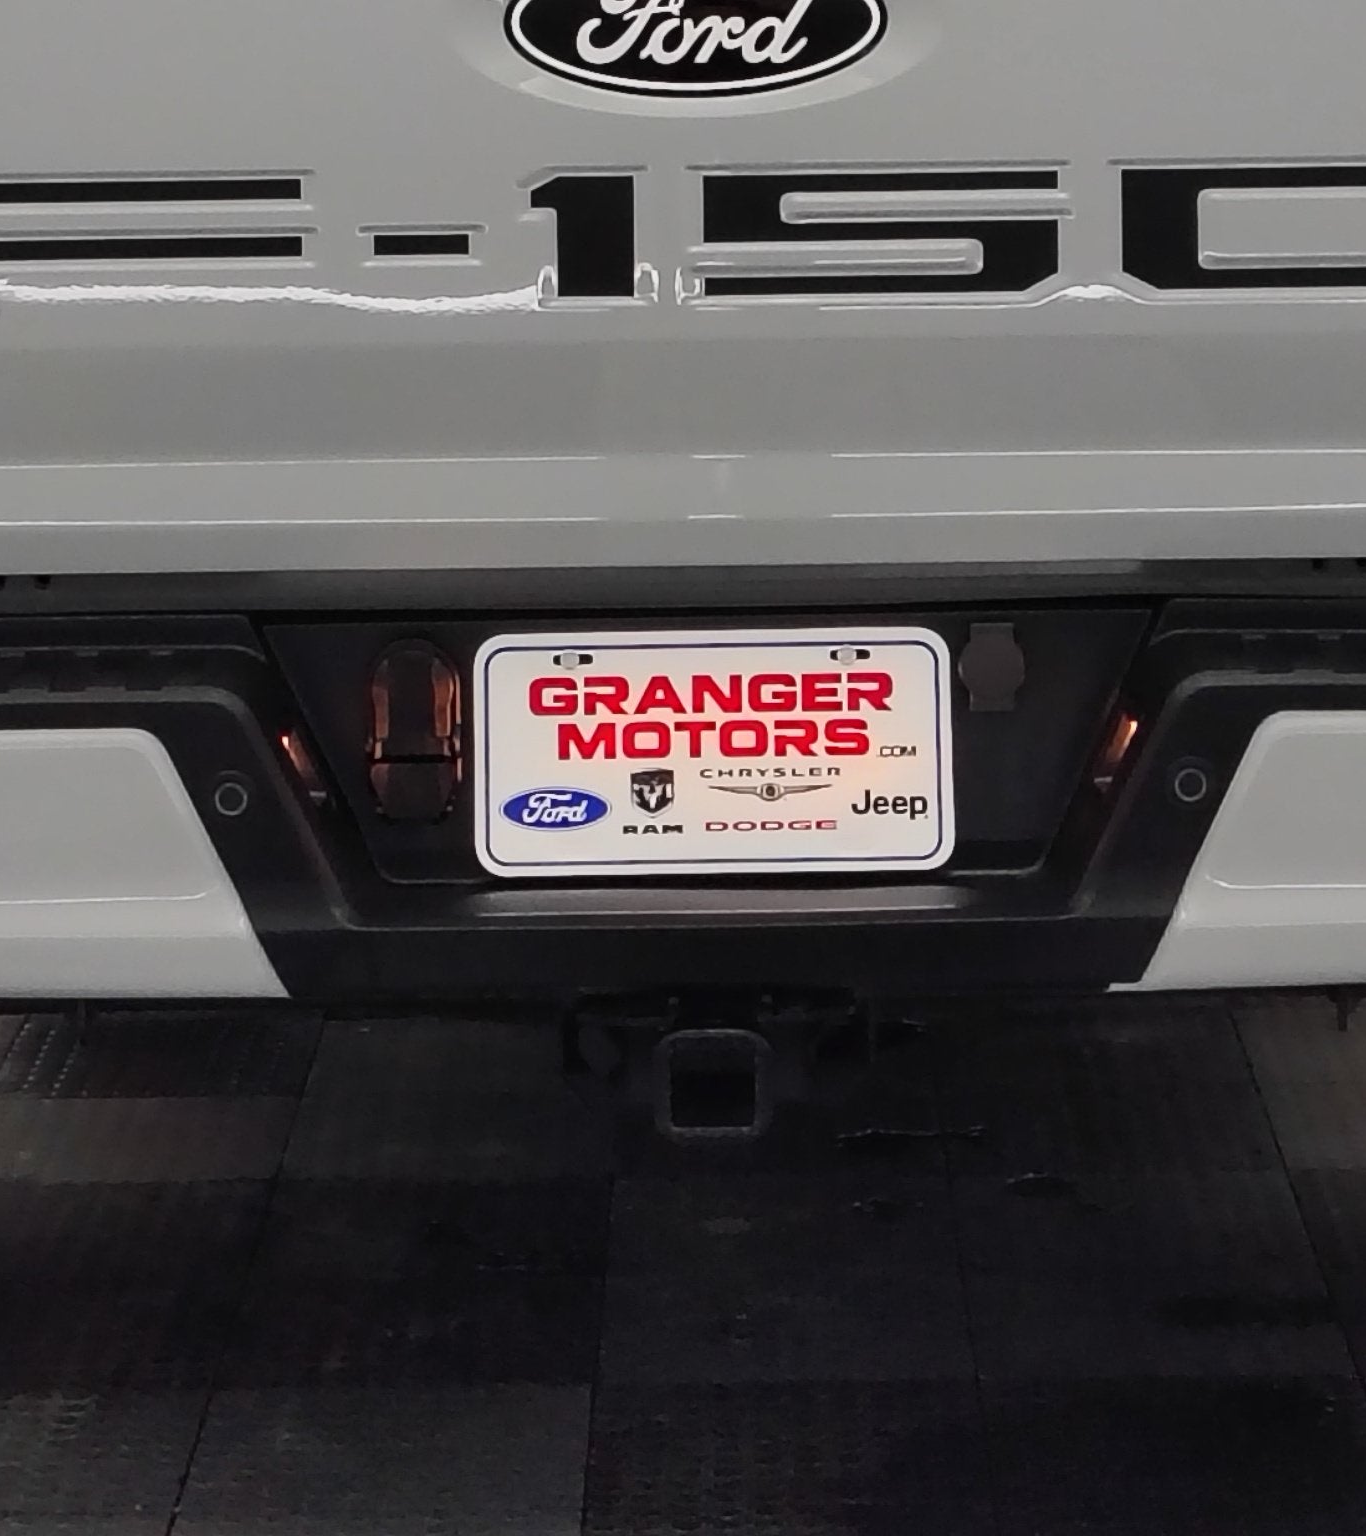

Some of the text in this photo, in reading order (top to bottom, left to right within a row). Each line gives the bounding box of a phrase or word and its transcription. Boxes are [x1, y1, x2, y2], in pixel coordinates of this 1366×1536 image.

[529, 671, 893, 716] GRANGER
[557, 718, 871, 760] MOTORS
[699, 767, 841, 779] CHRYSLER
[521, 792, 588, 824] Ford
[851, 789, 929, 821] Jeep
[622, 824, 684, 835] RAM
[705, 819, 838, 832] DODGE
